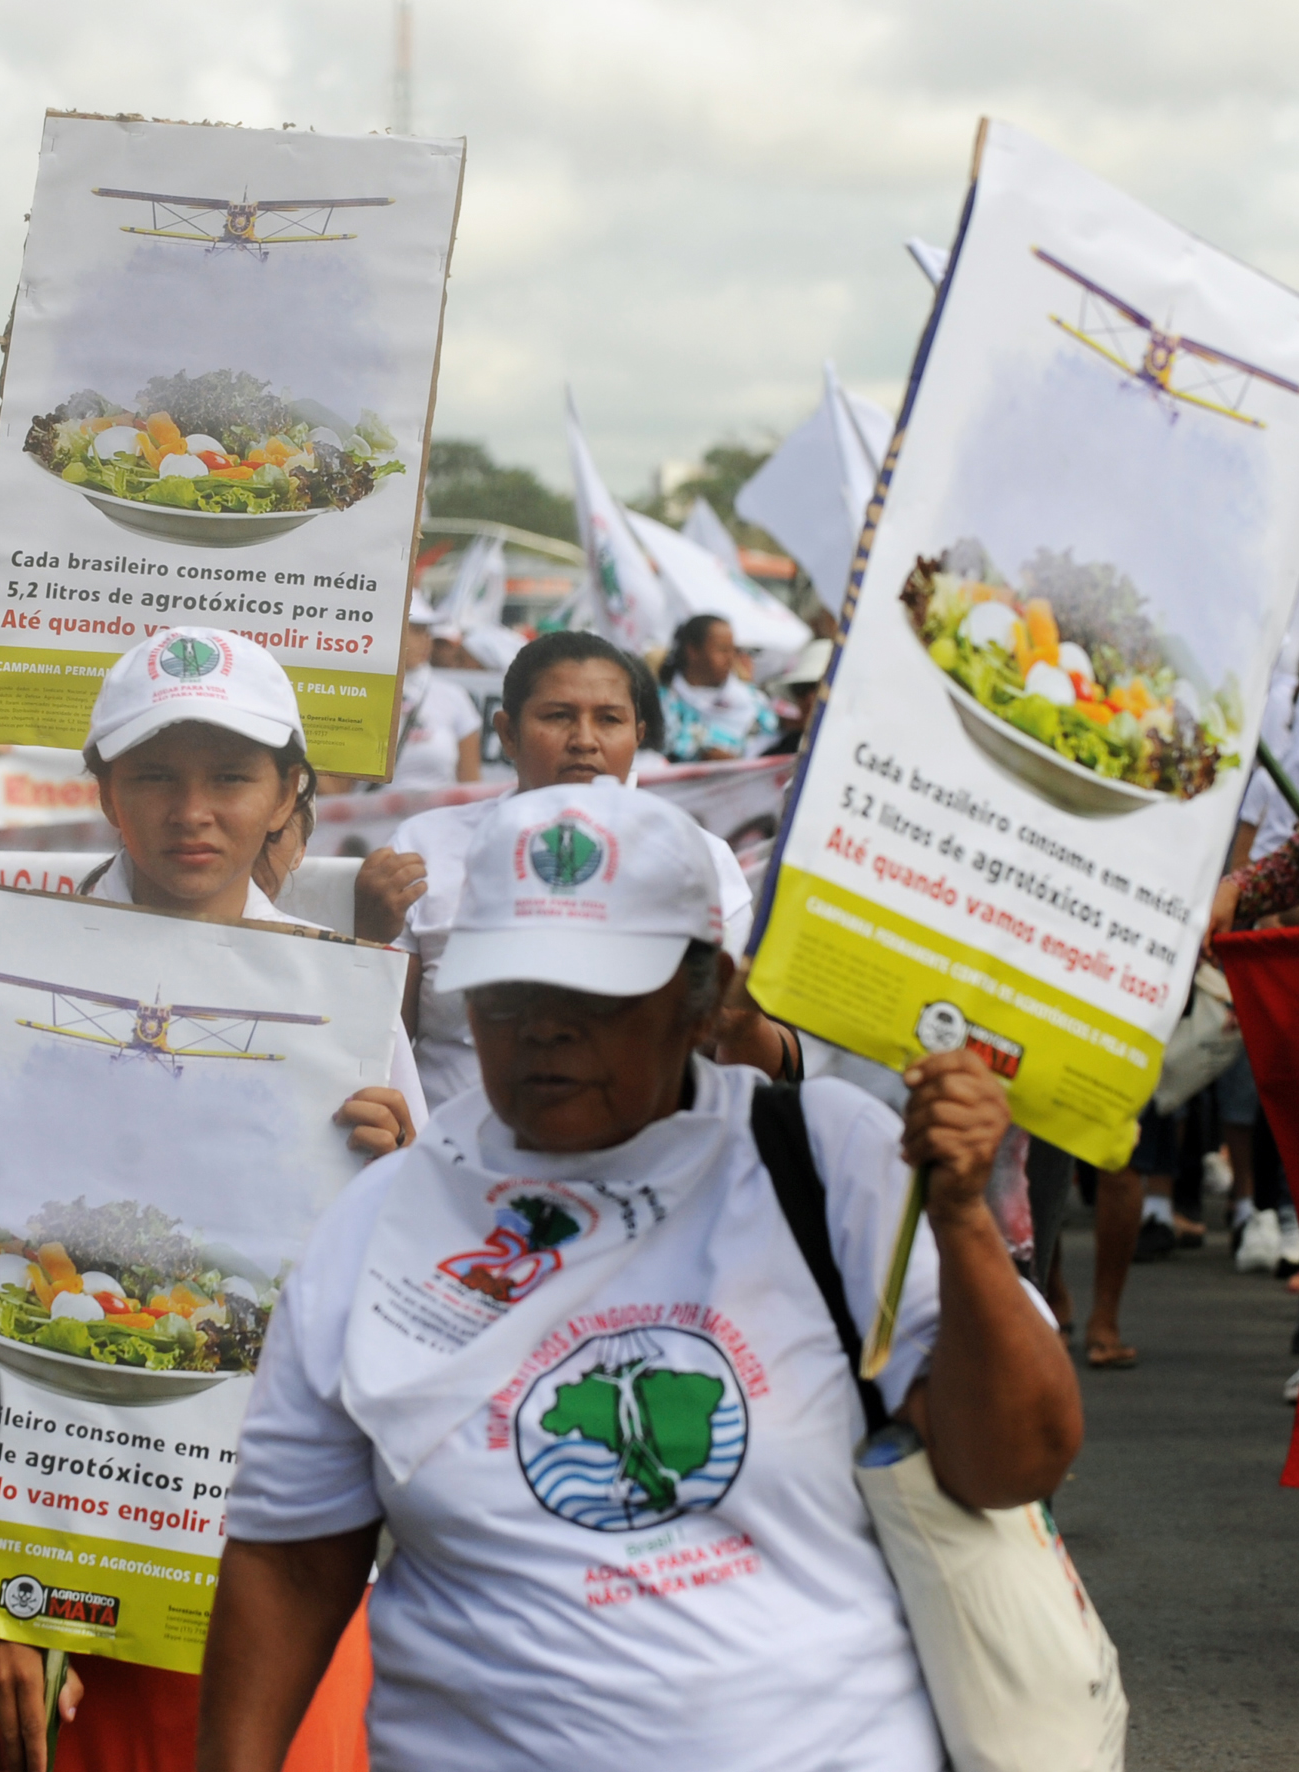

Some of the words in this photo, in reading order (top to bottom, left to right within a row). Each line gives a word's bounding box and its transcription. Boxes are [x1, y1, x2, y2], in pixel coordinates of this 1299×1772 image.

[11, 550, 60, 568] Cada
[68, 552, 169, 576] brasileiro
[177, 566, 267, 583] consome
[274, 572, 305, 586] em
[313, 572, 377, 592] média
[7, 581, 38, 600] 5,2
[46, 582, 100, 602] litros
[108, 587, 133, 605] de
[141, 591, 283, 615] agrotóxicos
[292, 605, 328, 620] por
[335, 608, 373, 623] ano
[2, 609, 41, 630] Até
[49, 616, 136, 636] quando
[226, 628, 309, 650] ngolir
[316, 631, 373, 654] isso?
[297, 682, 304, 692] E
[307, 682, 336, 695] PELA
[339, 685, 367, 698] VIDA
[854, 742, 903, 784] Cada
[909, 769, 1010, 833] brasileiro
[1018, 826, 1095, 877] consome
[1101, 869, 1130, 893] em
[1135, 886, 1191, 925] média
[841, 785, 874, 819] 5,2
[878, 804, 932, 847] litros
[938, 835, 965, 862] de
[972, 852, 1102, 928] agrotóxicos
[1107, 921, 1142, 945] por
[1146, 939, 1178, 967] ano
[826, 826, 866, 865] Até
[873, 855, 958, 907] quando
[966, 897, 1036, 944] vamos
[1040, 934, 1116, 980] engolir
[1120, 973, 1169, 1007] isso?
[65, 1423, 165, 1452] consome
[175, 1442, 209, 1460] em
[25, 1451, 183, 1492] agrotóxicos
[28, 1488, 109, 1516] vamos
[118, 1504, 211, 1533] engolir
[25, 1543, 74, 1563] CONTRA
[78, 1552, 97, 1566] OS
[99, 1555, 191, 1583] AGROTÓXICOS
[194, 1572, 203, 1585] E
[49, 1597, 115, 1626] MATA
[51, 1589, 115, 1607] AGROTÓXICO
